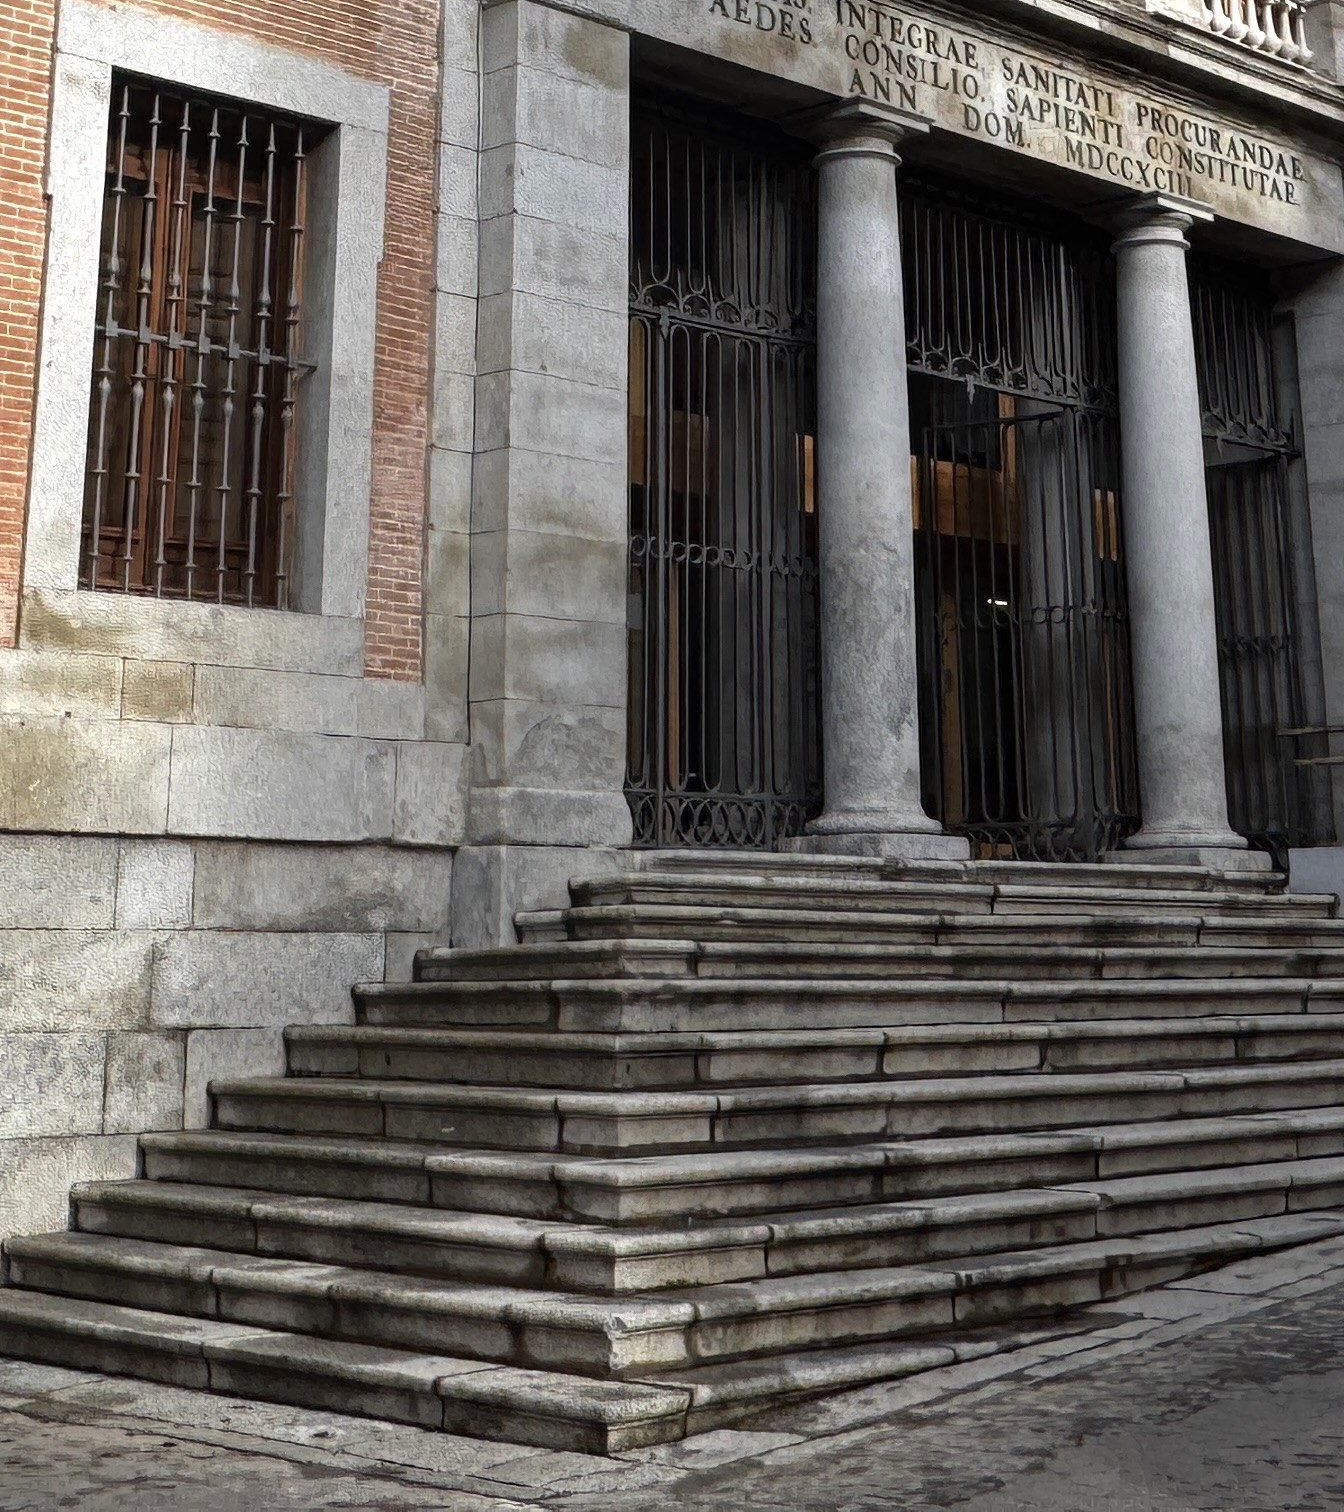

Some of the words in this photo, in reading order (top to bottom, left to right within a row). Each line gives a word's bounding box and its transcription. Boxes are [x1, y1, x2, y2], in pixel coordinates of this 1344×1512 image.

[1001, 57, 1116, 117] SANITATI
[1135, 101, 1306, 182] PROCURANDAE
[1006, 87, 1123, 148] SAPIENTI
[1145, 135, 1300, 205] CONSTITUTAE
[1064, 135, 1193, 199] MDCCXCIII
